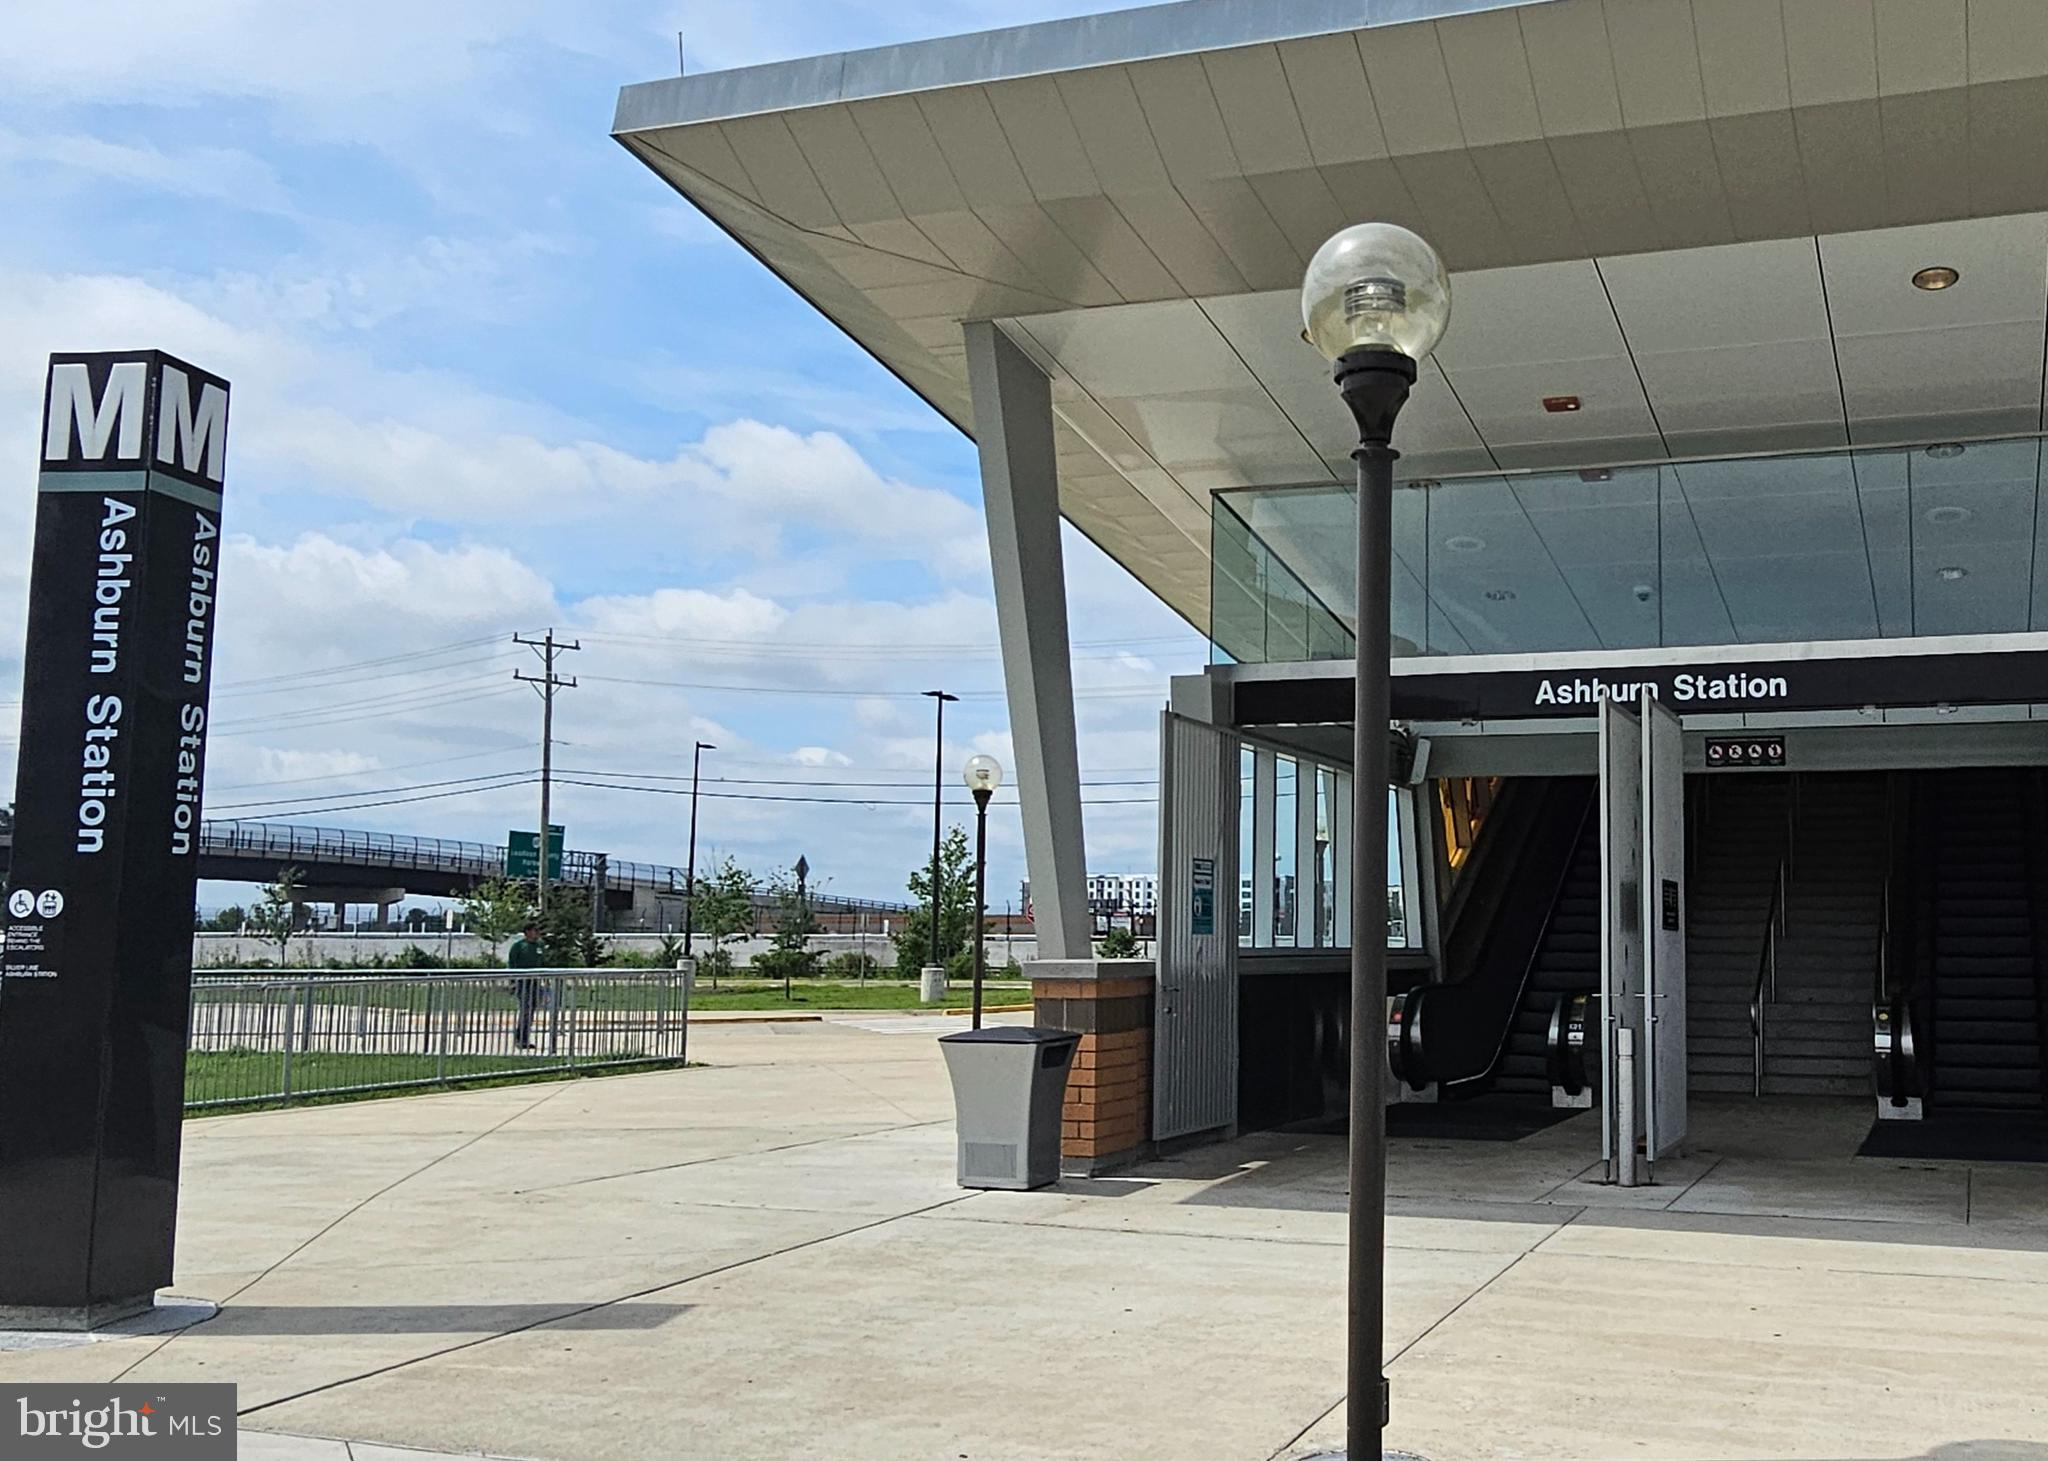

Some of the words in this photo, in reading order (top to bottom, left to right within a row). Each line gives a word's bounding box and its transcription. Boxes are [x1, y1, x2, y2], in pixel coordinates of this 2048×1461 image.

[45, 362, 147, 460] M
[156, 364, 228, 482] M
[90, 497, 136, 673] Ashburn
[183, 512, 216, 683] Ashburn
[1535, 678, 1659, 705] Ashburn
[1673, 673, 1787, 700] Station
[76, 695, 122, 853] Station
[171, 704, 204, 855] Station
